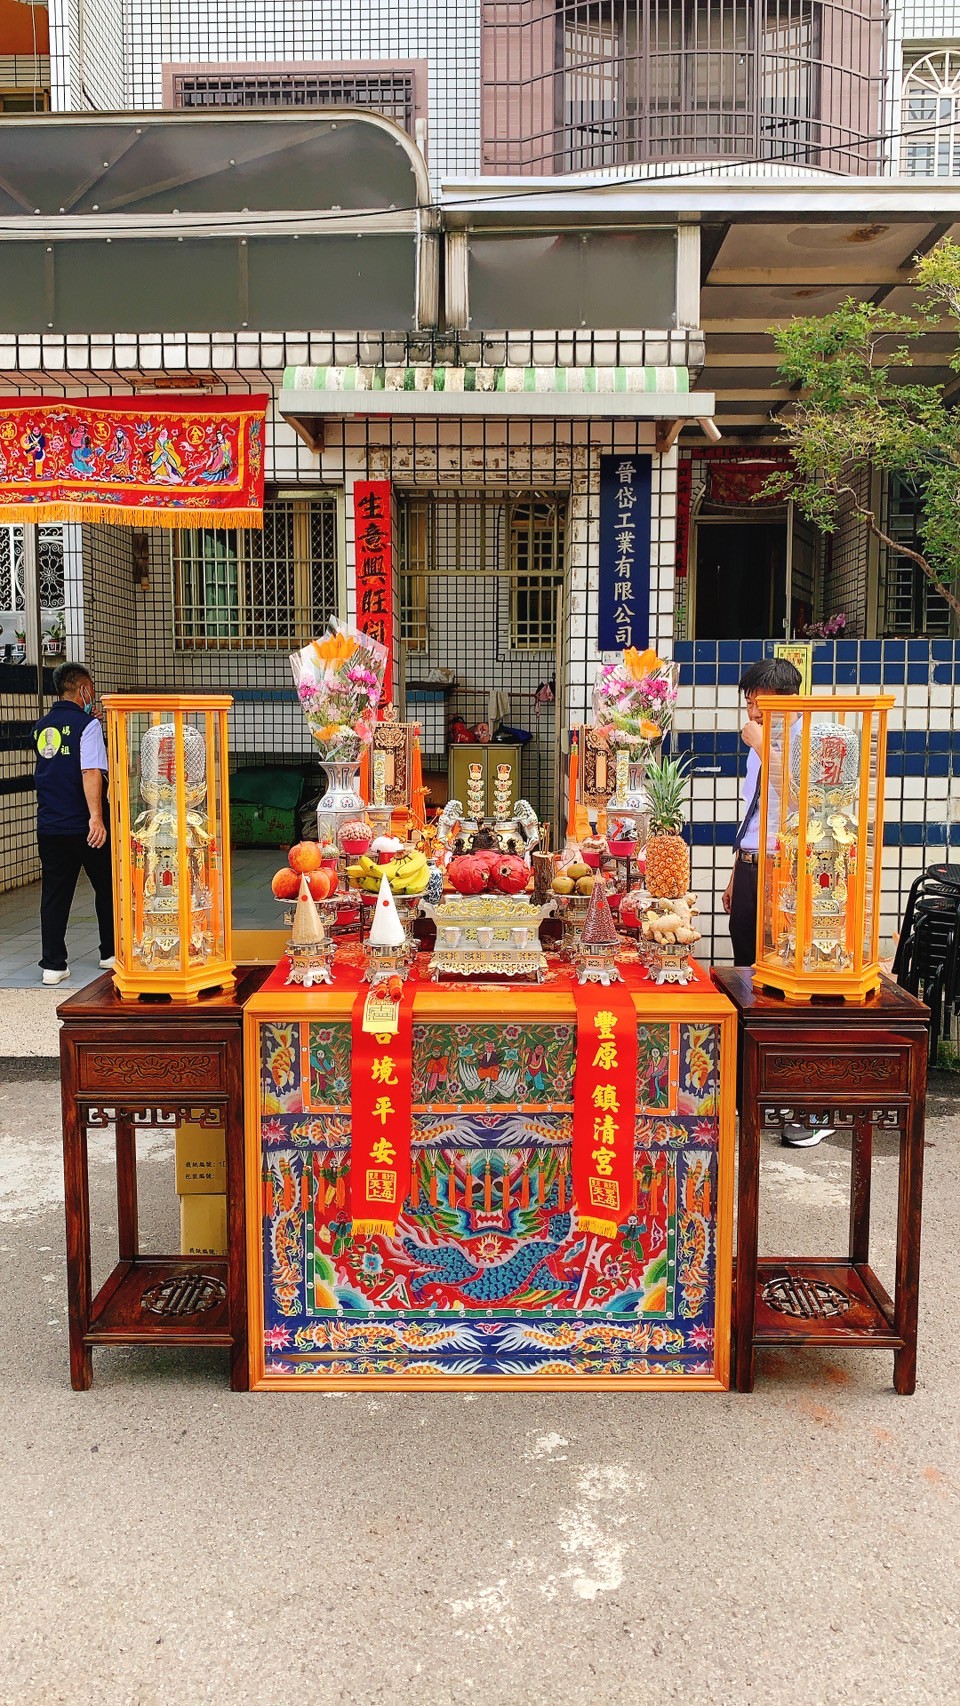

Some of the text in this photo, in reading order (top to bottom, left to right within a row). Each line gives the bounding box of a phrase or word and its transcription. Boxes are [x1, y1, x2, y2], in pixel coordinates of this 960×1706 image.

[613, 461, 637, 647] 晉岱工業有限公司
[592, 1010, 619, 1071] 豐原
[591, 1083, 621, 1176] 鎮清宮
